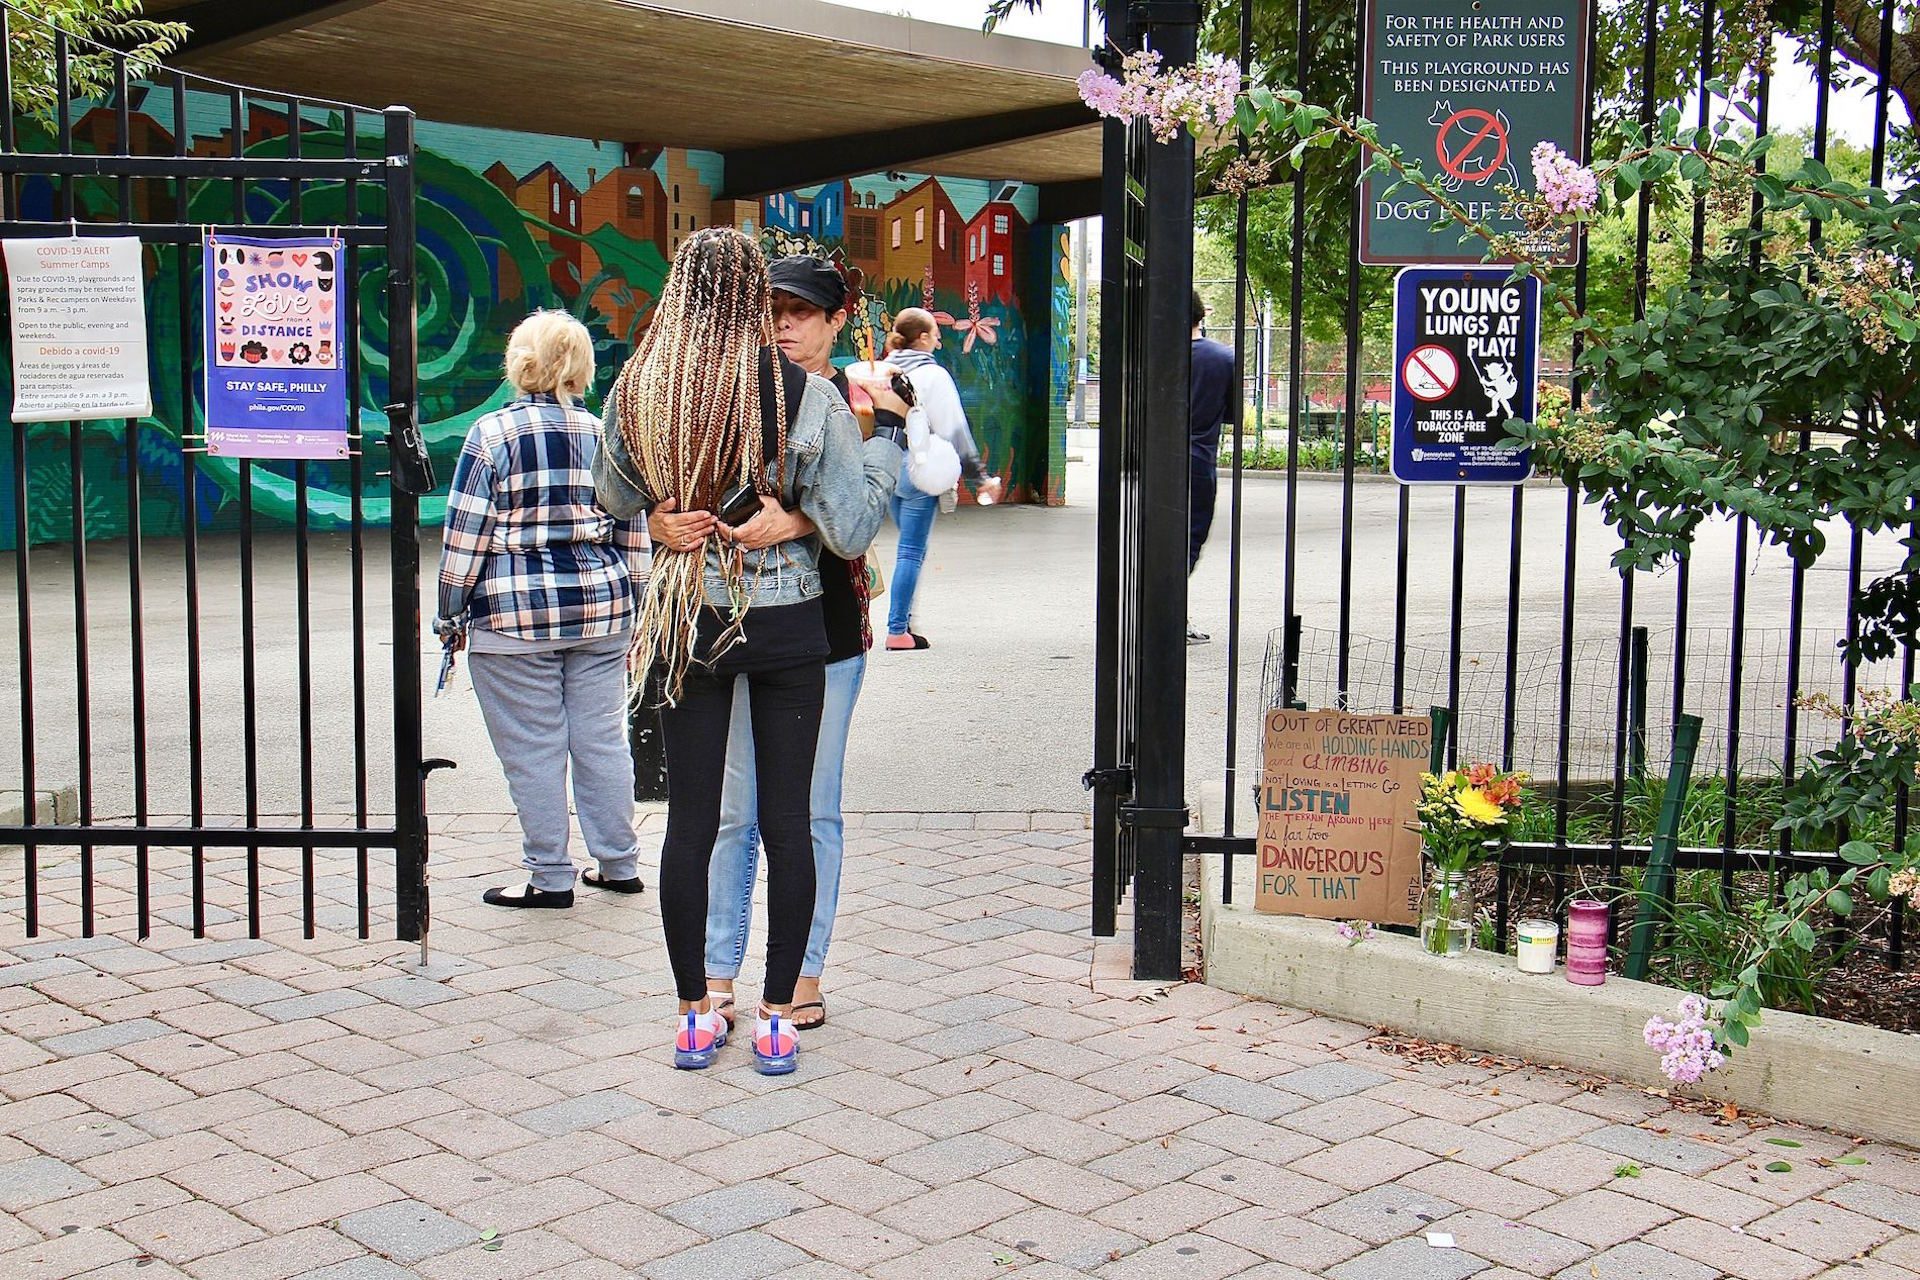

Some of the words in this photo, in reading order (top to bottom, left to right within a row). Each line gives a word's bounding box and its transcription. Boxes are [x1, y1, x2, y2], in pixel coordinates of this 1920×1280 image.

[1386, 15, 1418, 29] FOR
[1422, 17, 1454, 29] THE
[1460, 17, 1521, 29] HEALTH
[1527, 17, 1564, 29] AND
[1387, 33, 1441, 47] SAFETY
[1445, 33, 1467, 47] OF
[1473, 32, 1514, 47] PARK
[1519, 34, 1565, 47] USERS
[1380, 60, 1418, 75] THIS
[1425, 62, 1533, 75] PLAYGROUND
[1539, 62, 1569, 75] HAS
[1394, 80, 1433, 92] BEEN
[1439, 80, 1540, 92] DESIGNATED
[1545, 80, 1556, 92] A
[1375, 201, 1429, 220] DOG
[37, 247, 82, 256] COVID-19
[84, 246, 110, 255] ALERT
[40, 260, 78, 269] Summer
[81, 260, 110, 270] Camps
[79, 275, 120, 284] playgrounds
[244, 272, 313, 293] SHOW
[38, 286, 67, 294] grounds
[102, 296, 137, 304] Weekdays
[240, 291, 312, 321] Love
[1420, 287, 1520, 314] YOUNG
[63, 321, 86, 329] public,
[88, 321, 114, 329] evening
[242, 325, 312, 337] DISTANCE
[1425, 315, 1489, 335] LUNGS
[1496, 315, 1520, 335] AT
[40, 347, 72, 355] Debido
[82, 347, 120, 355] covid-19
[1467, 337, 1516, 357] PLAY!
[51, 362, 74, 370] juegos
[226, 381, 255, 391] STAY
[257, 382, 288, 393] SAFE,
[290, 383, 327, 393] PHILLY
[249, 403, 305, 412] phila.gov/COVID
[1430, 410, 1451, 420] THIS
[1454, 410, 1463, 420] IS
[1466, 410, 1473, 420] A
[1417, 421, 1486, 431] TOBACCO-FREE
[1438, 432, 1465, 443] ZONE
[1271, 714, 1309, 732] OUT
[1315, 718, 1333, 732] OF
[1338, 718, 1384, 735] GREAT
[1386, 719, 1428, 736] NEED
[1268, 737, 1284, 750] We
[1286, 741, 1301, 750] are
[1303, 738, 1316, 750] all
[1323, 736, 1377, 755] HOLDING
[1381, 739, 1429, 759] HANDS
[1268, 752, 1294, 766] and
[1303, 754, 1389, 774] CLIMBING
[1265, 774, 1283, 783] NOT
[1266, 786, 1350, 815] LISTEN
[1264, 812, 1280, 820] THE
[1283, 823, 1303, 848] far
[1306, 822, 1330, 841] too
[1262, 844, 1384, 876] DANGEROUS
[1263, 874, 1299, 897] FOR
[1306, 876, 1361, 900] THAT
[1408, 876, 1420, 911] HAFIZ
